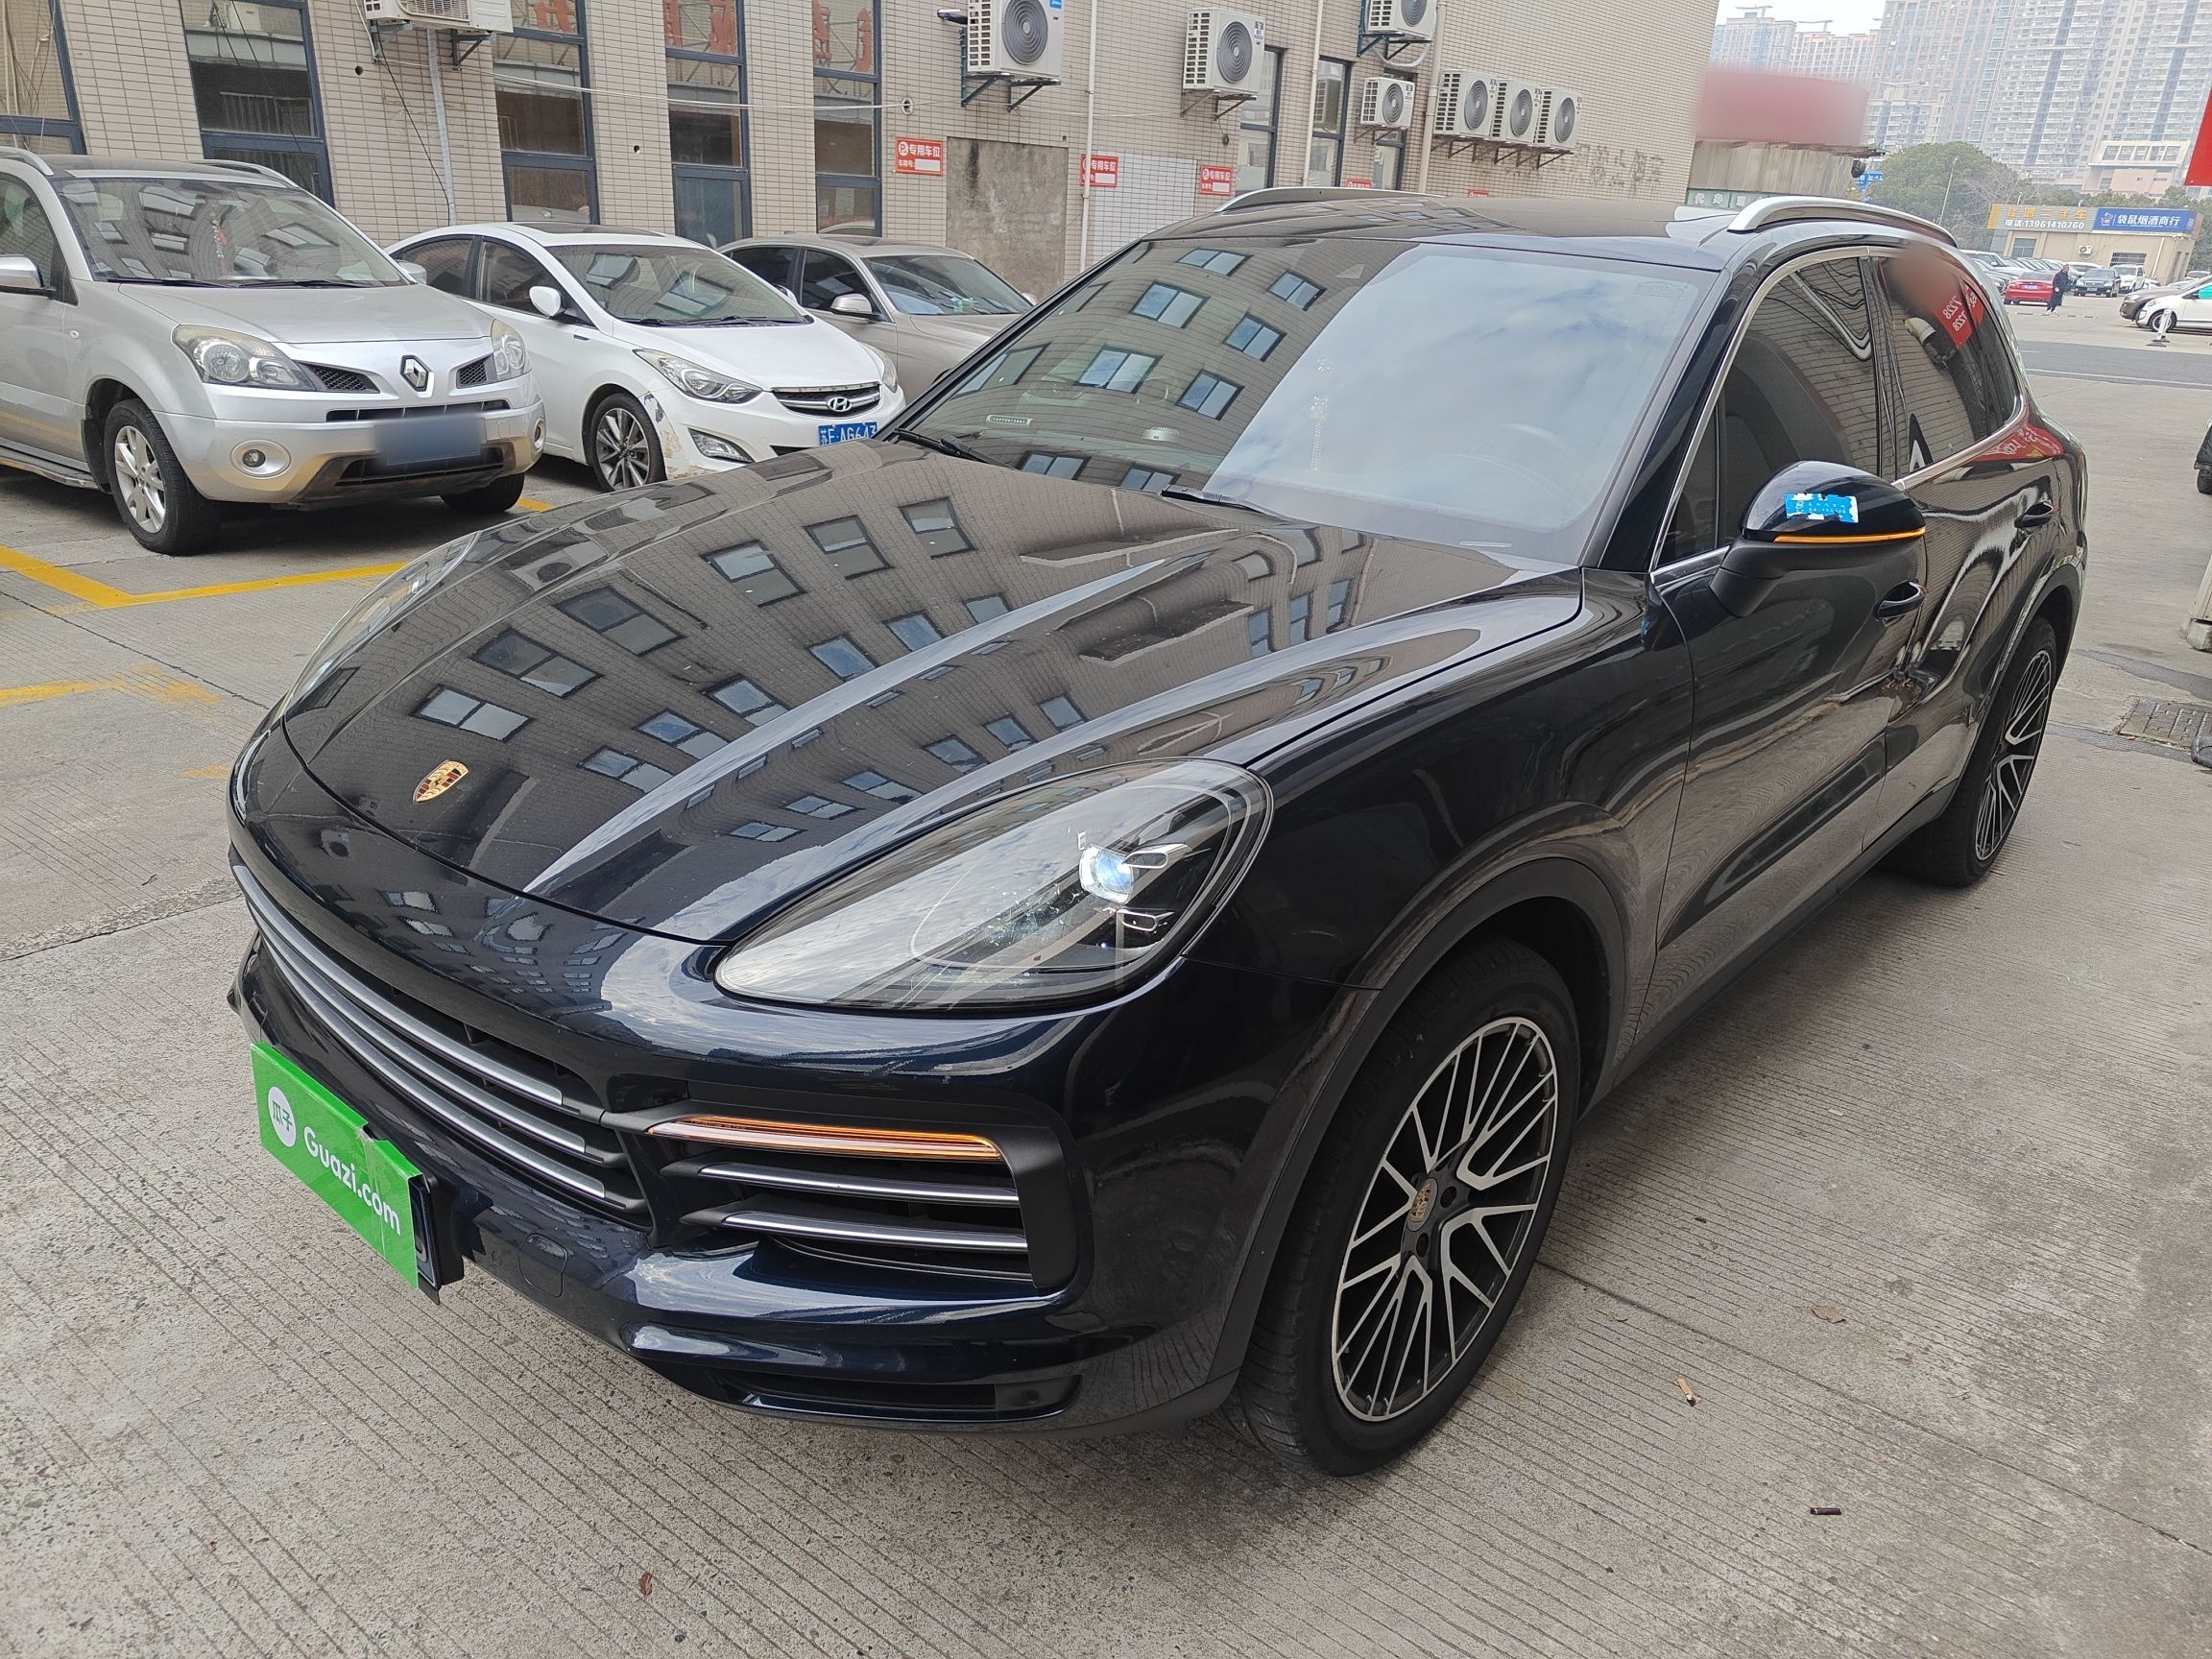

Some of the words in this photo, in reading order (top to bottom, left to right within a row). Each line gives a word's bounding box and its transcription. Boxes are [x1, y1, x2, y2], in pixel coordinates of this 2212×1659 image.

[909, 144, 941, 157] 专用车位
[1092, 159, 1117, 172] 专用车位
[2116, 213, 2181, 227] 袋鼠烟酒商行
[272, 1099, 294, 1133] 瓜子
[303, 1126, 401, 1237] Guazi.com
